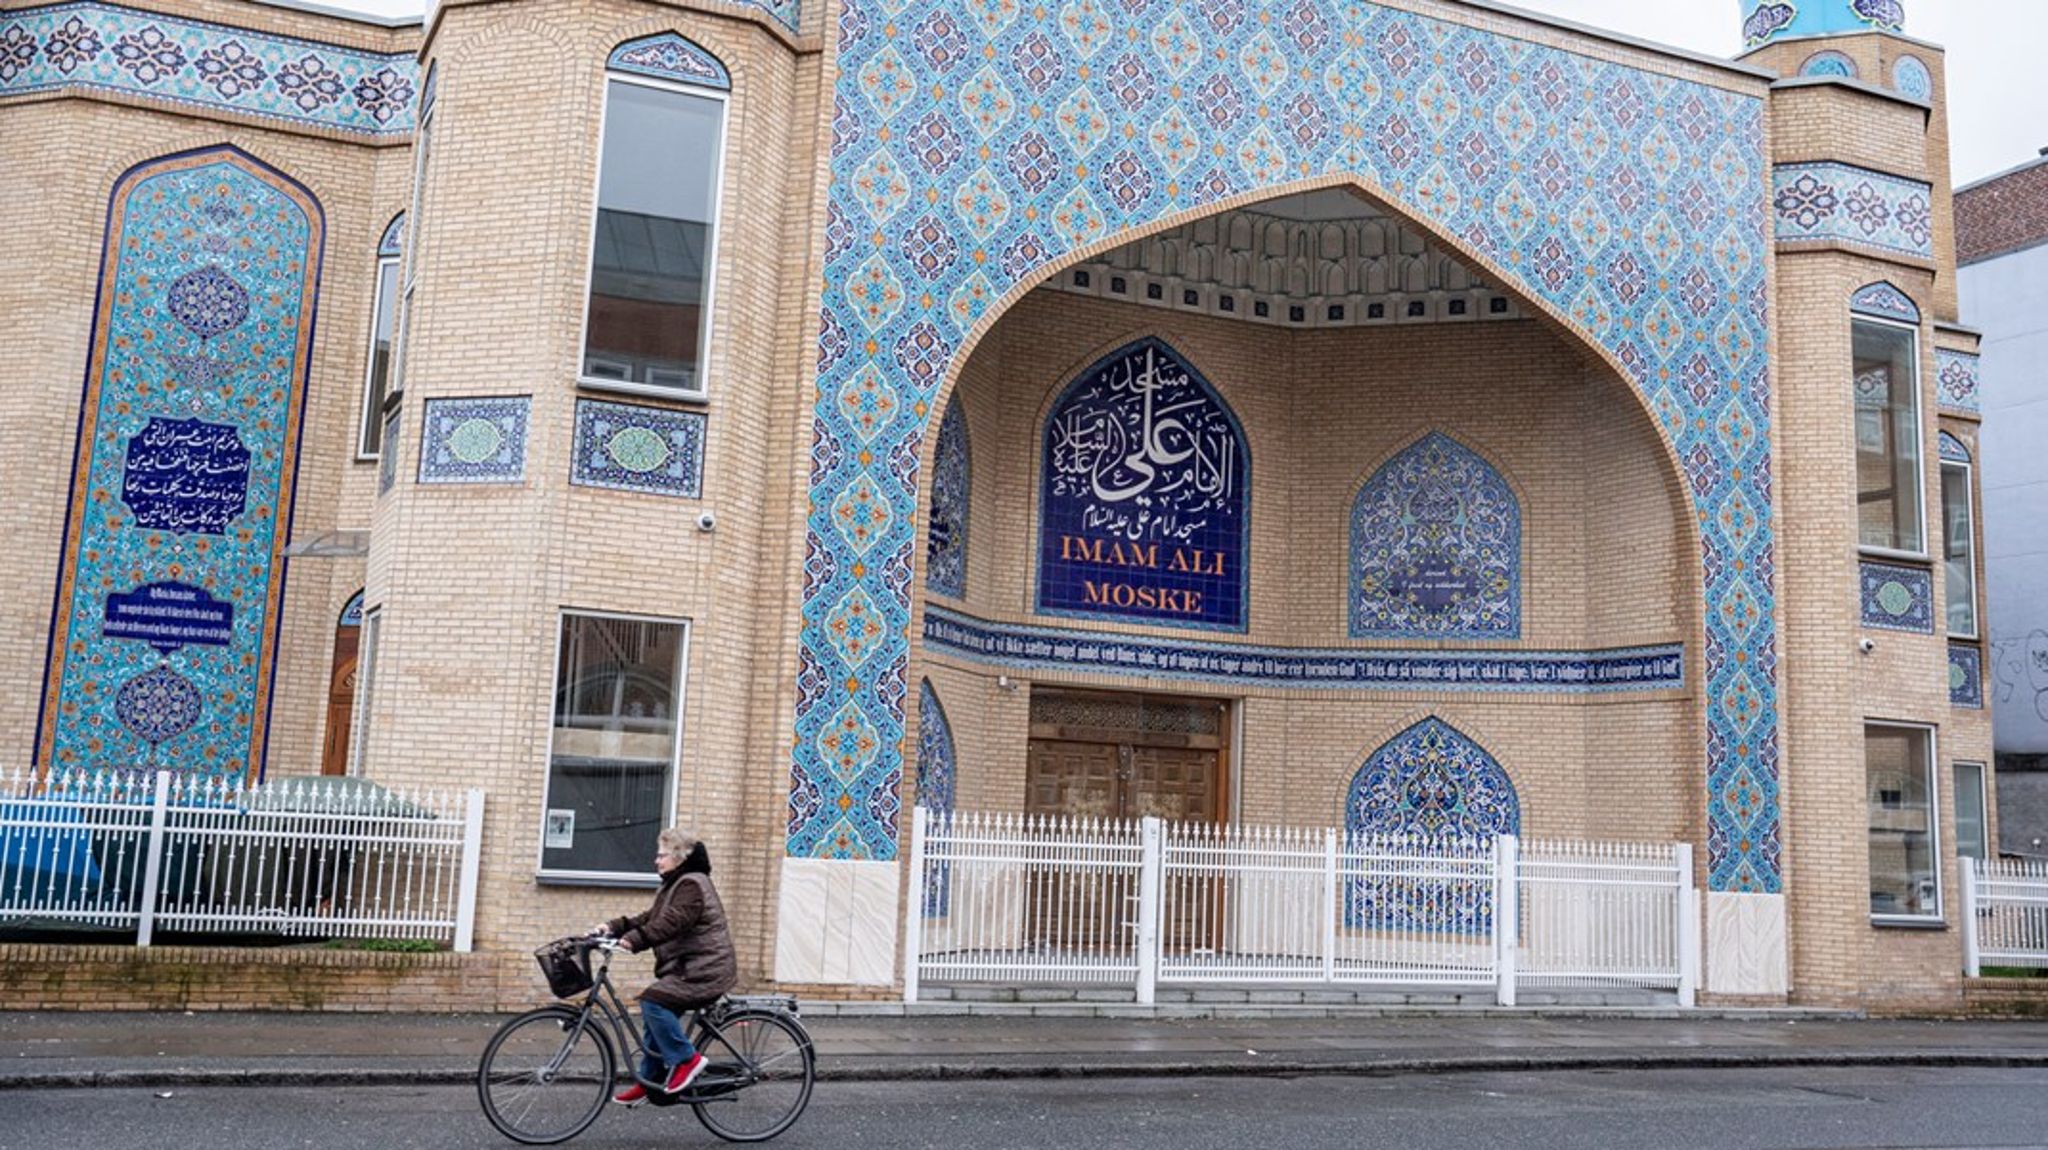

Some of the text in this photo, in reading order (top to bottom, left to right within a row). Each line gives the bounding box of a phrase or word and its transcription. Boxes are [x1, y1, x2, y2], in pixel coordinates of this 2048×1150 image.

[1173, 519, 1207, 545] مسجد
[1060, 536, 1226, 576] IMAM ALI
[1084, 580, 1202, 614] MOSKE
